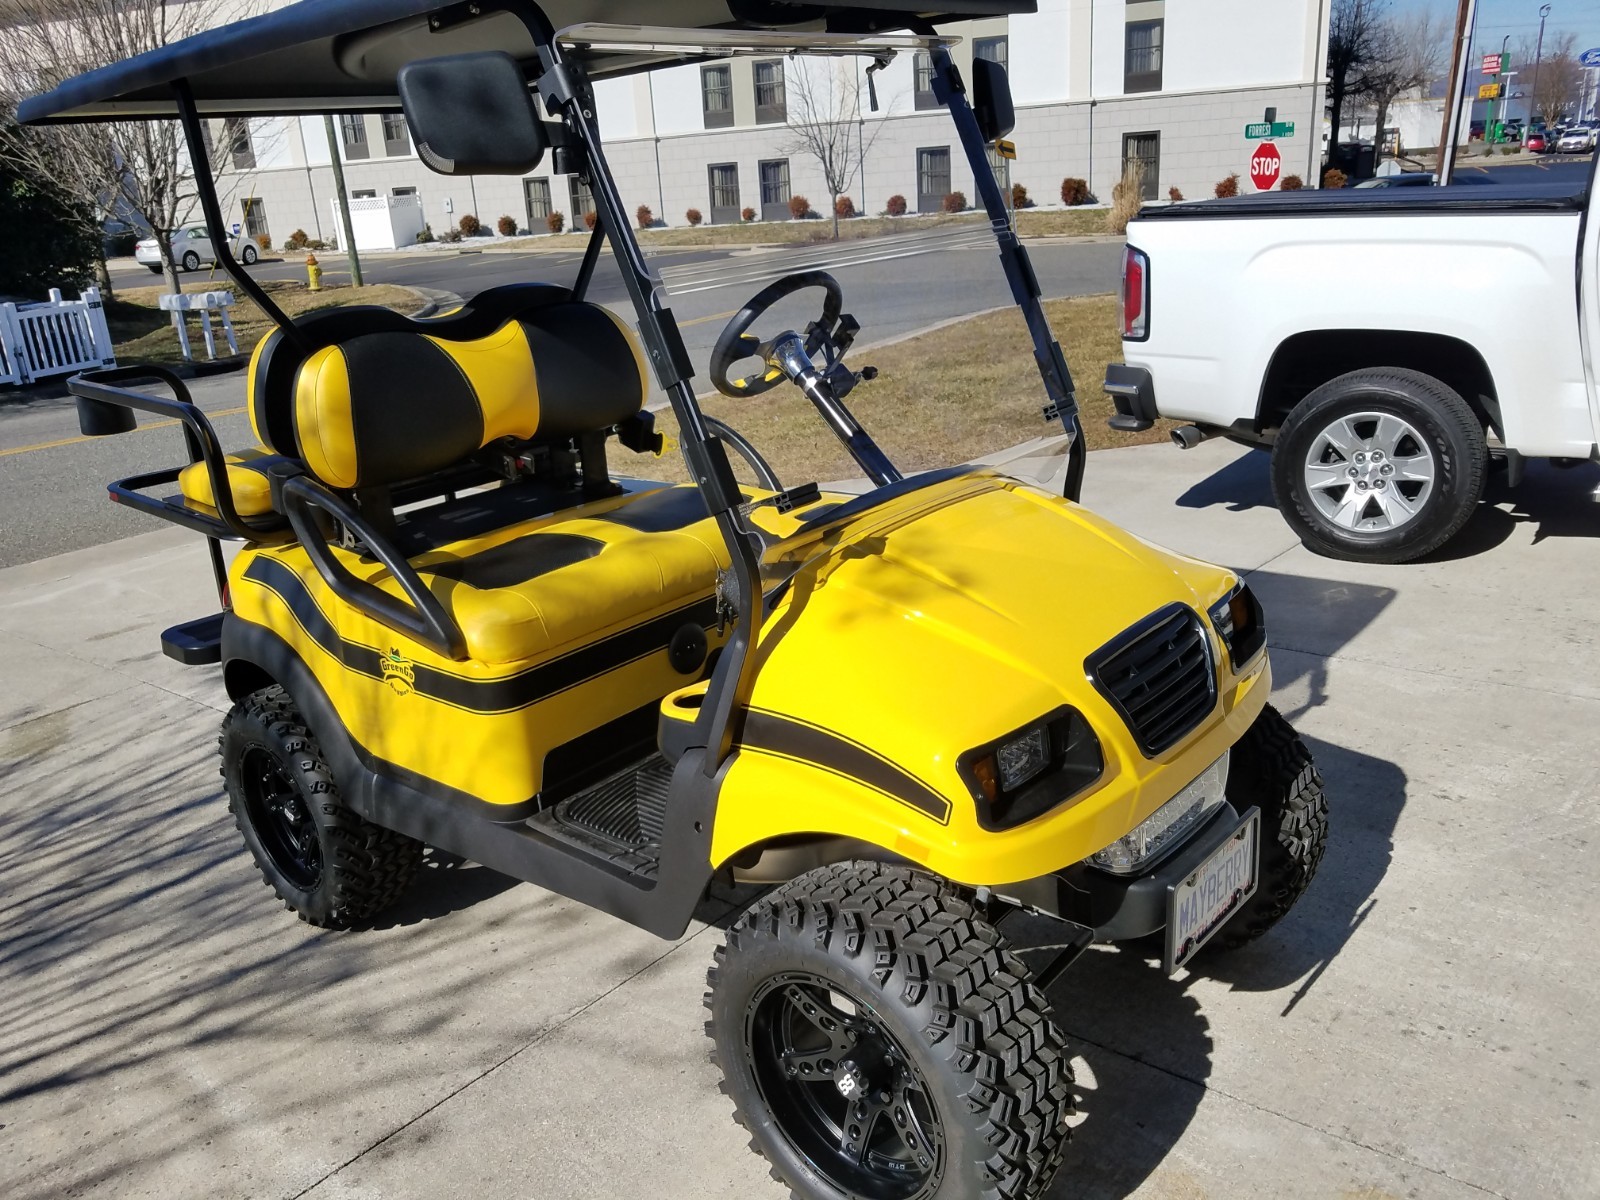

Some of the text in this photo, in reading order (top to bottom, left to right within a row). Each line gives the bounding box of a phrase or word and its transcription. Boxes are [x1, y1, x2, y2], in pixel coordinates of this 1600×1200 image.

[1249, 125, 1271, 136] FORREST
[1252, 157, 1279, 175] STOP
[382, 660, 413, 679] GreenGo
[1179, 839, 1250, 939] MAYBERRY
